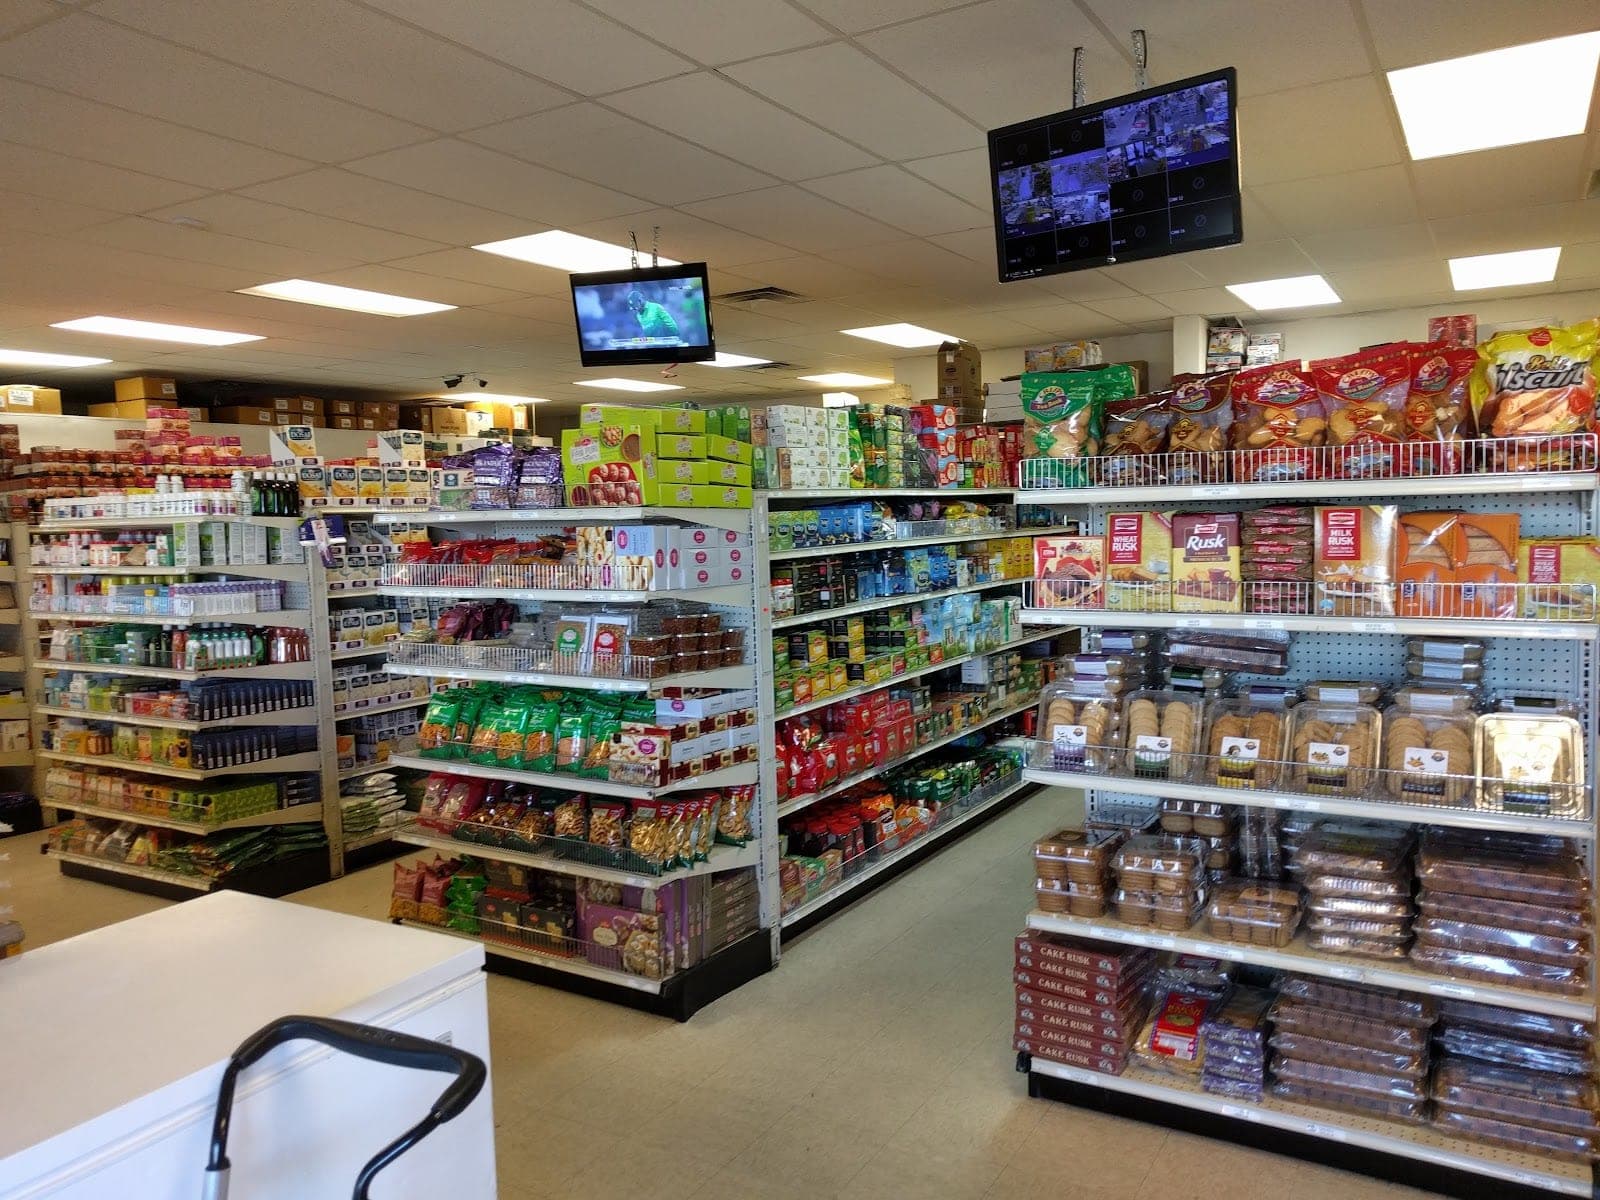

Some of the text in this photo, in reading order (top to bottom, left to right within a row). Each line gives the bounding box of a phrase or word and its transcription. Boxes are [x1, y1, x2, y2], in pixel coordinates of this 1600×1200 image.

[1112, 535, 1138, 543] WHEAT
[1186, 533, 1227, 551] Rusk
[1328, 536, 1355, 546] RUSK
[1330, 529, 1353, 537] MILK
[1111, 543, 1138, 551] RUSK
[1040, 947, 1090, 966] CAKE RUSK
[1039, 961, 1088, 981] CAKE RUSK
[1038, 978, 1087, 998] CAKE RUSK
[1040, 998, 1092, 1016] CAKE RUSK
[1042, 1014, 1094, 1033] CAKE RUSK
[1040, 1030, 1092, 1049] CAKE RUSK
[1038, 1046, 1089, 1065] CAKE RUSK
